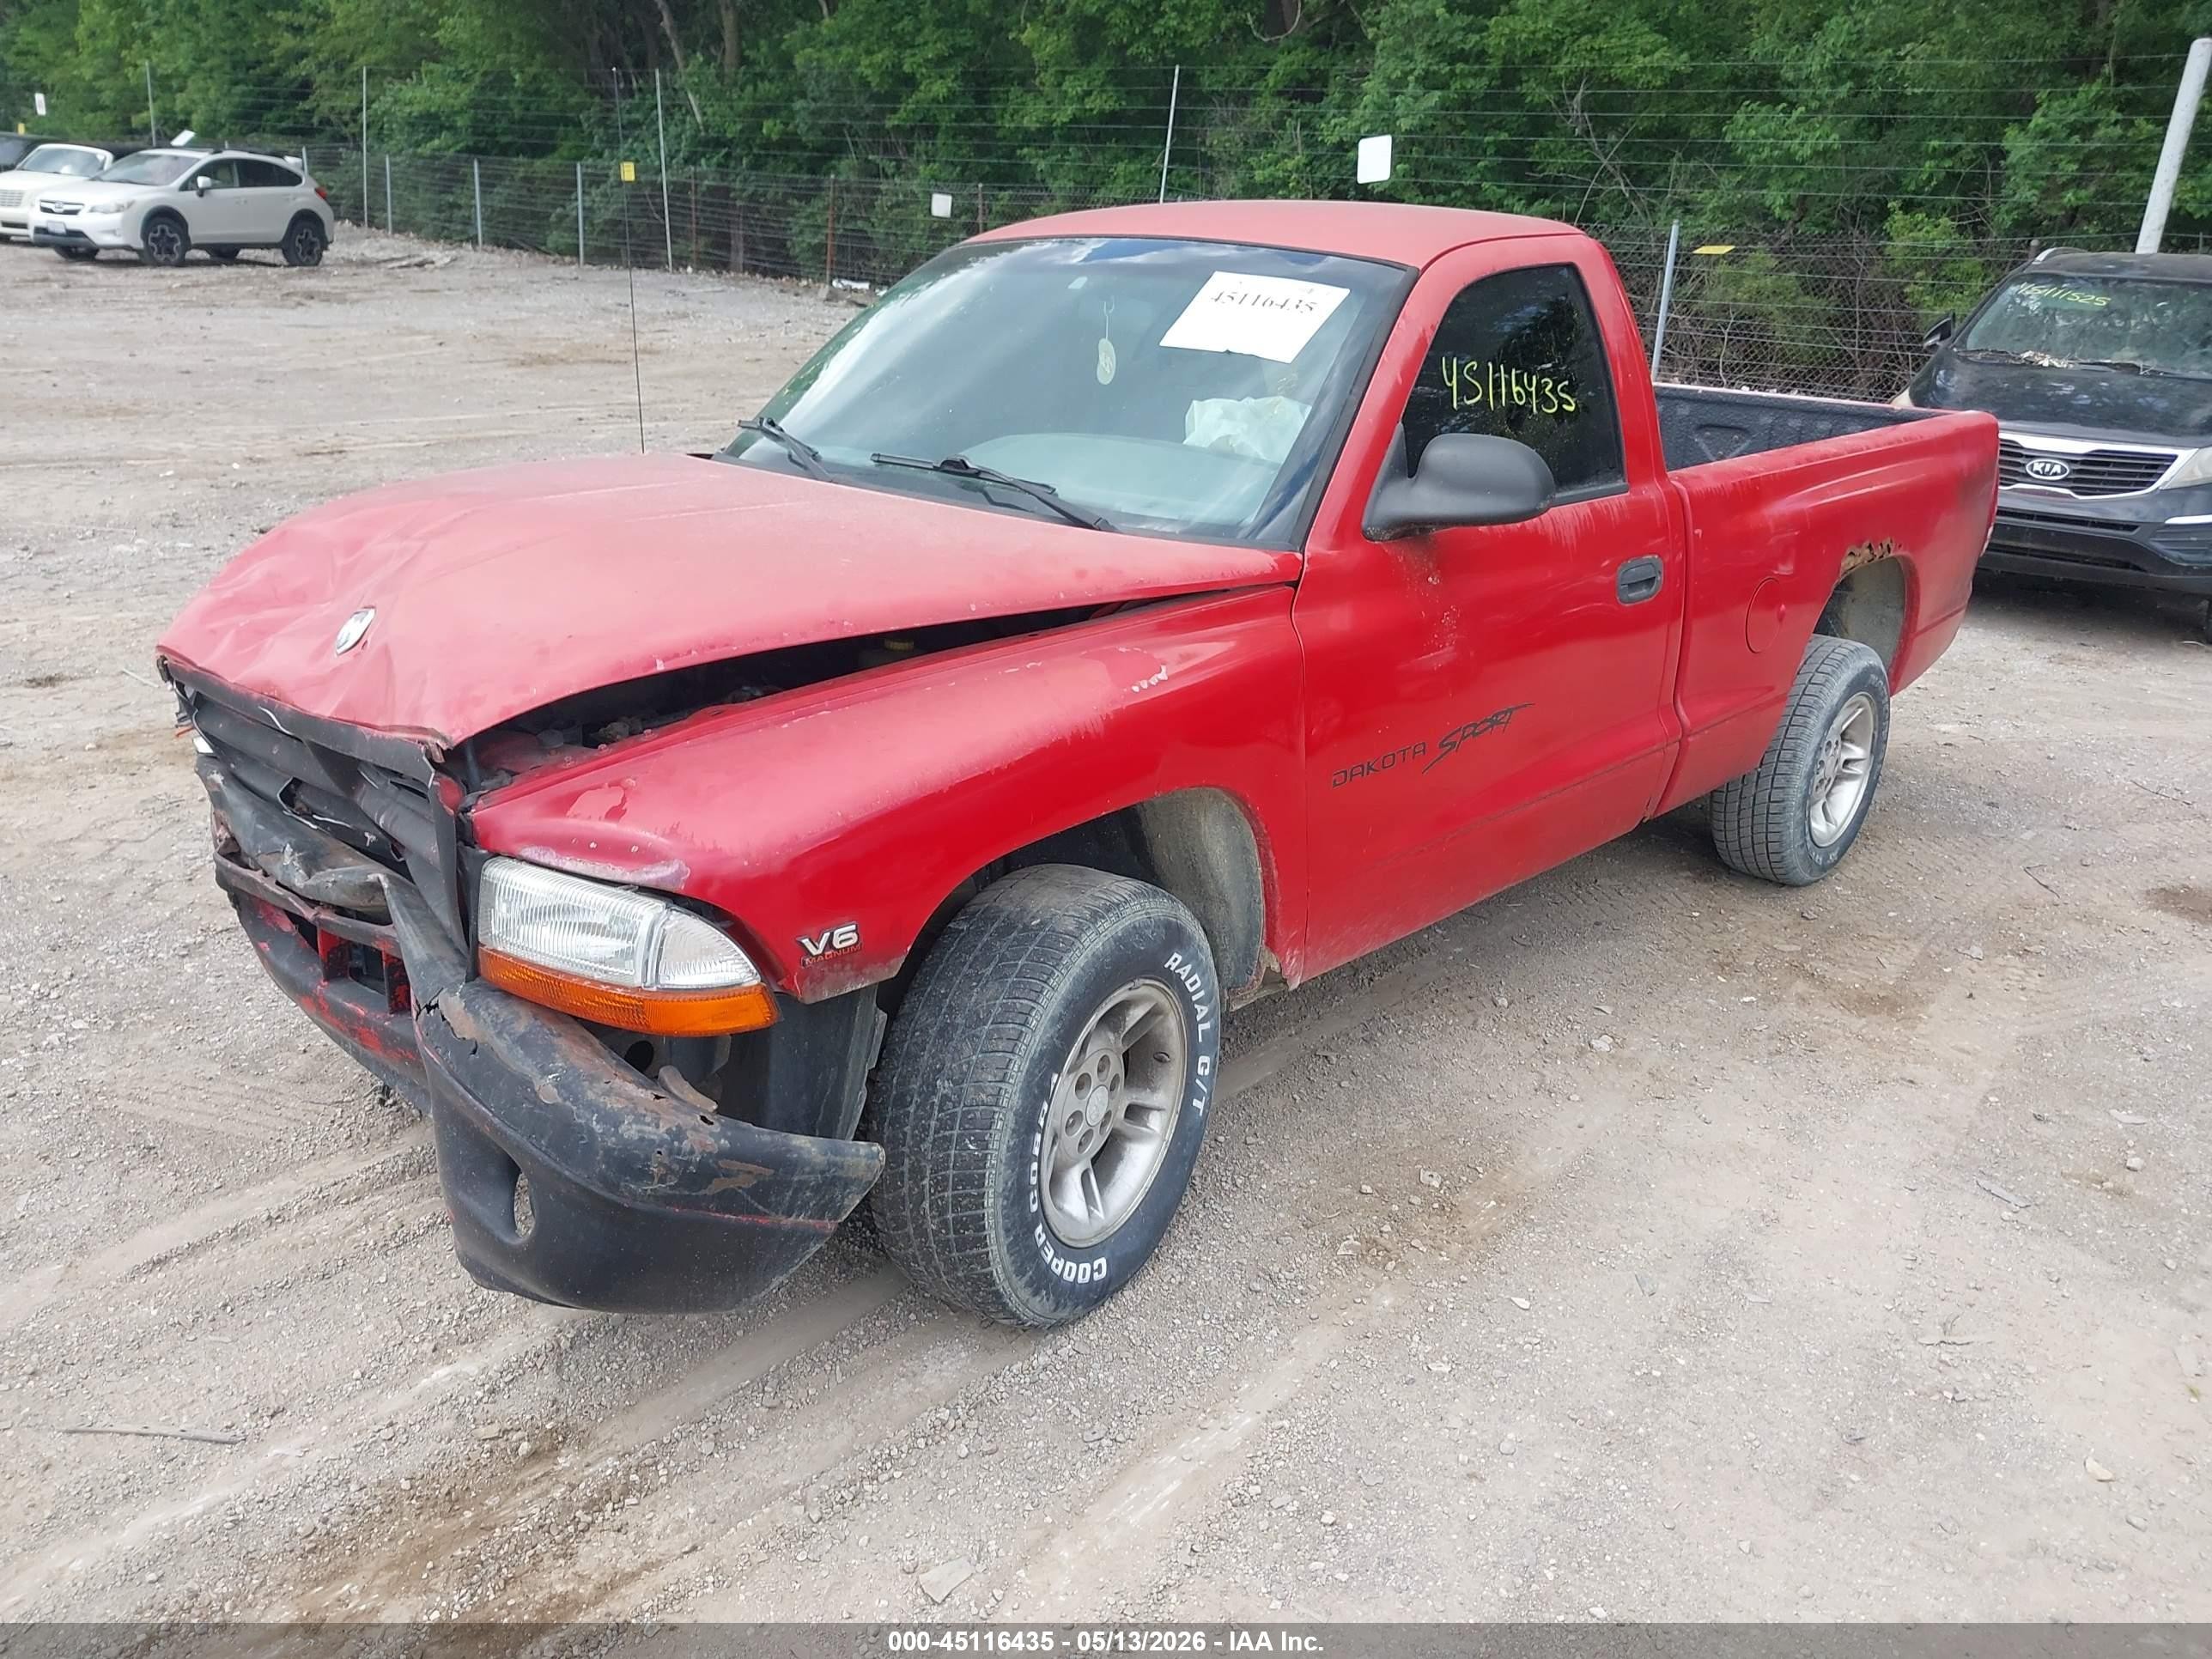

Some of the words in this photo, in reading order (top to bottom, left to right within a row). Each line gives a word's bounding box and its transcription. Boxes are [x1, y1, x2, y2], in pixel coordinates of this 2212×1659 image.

[1442, 356, 1576, 414] 45116435
[1333, 741, 1426, 788] DAKOTA
[1422, 702, 1535, 774] SPORT
[799, 922, 859, 957] V6
[805, 945, 861, 966] MAGNUM
[1164, 951, 1212, 1042] RADIAL
[1034, 1222, 1108, 1284] COOPER
